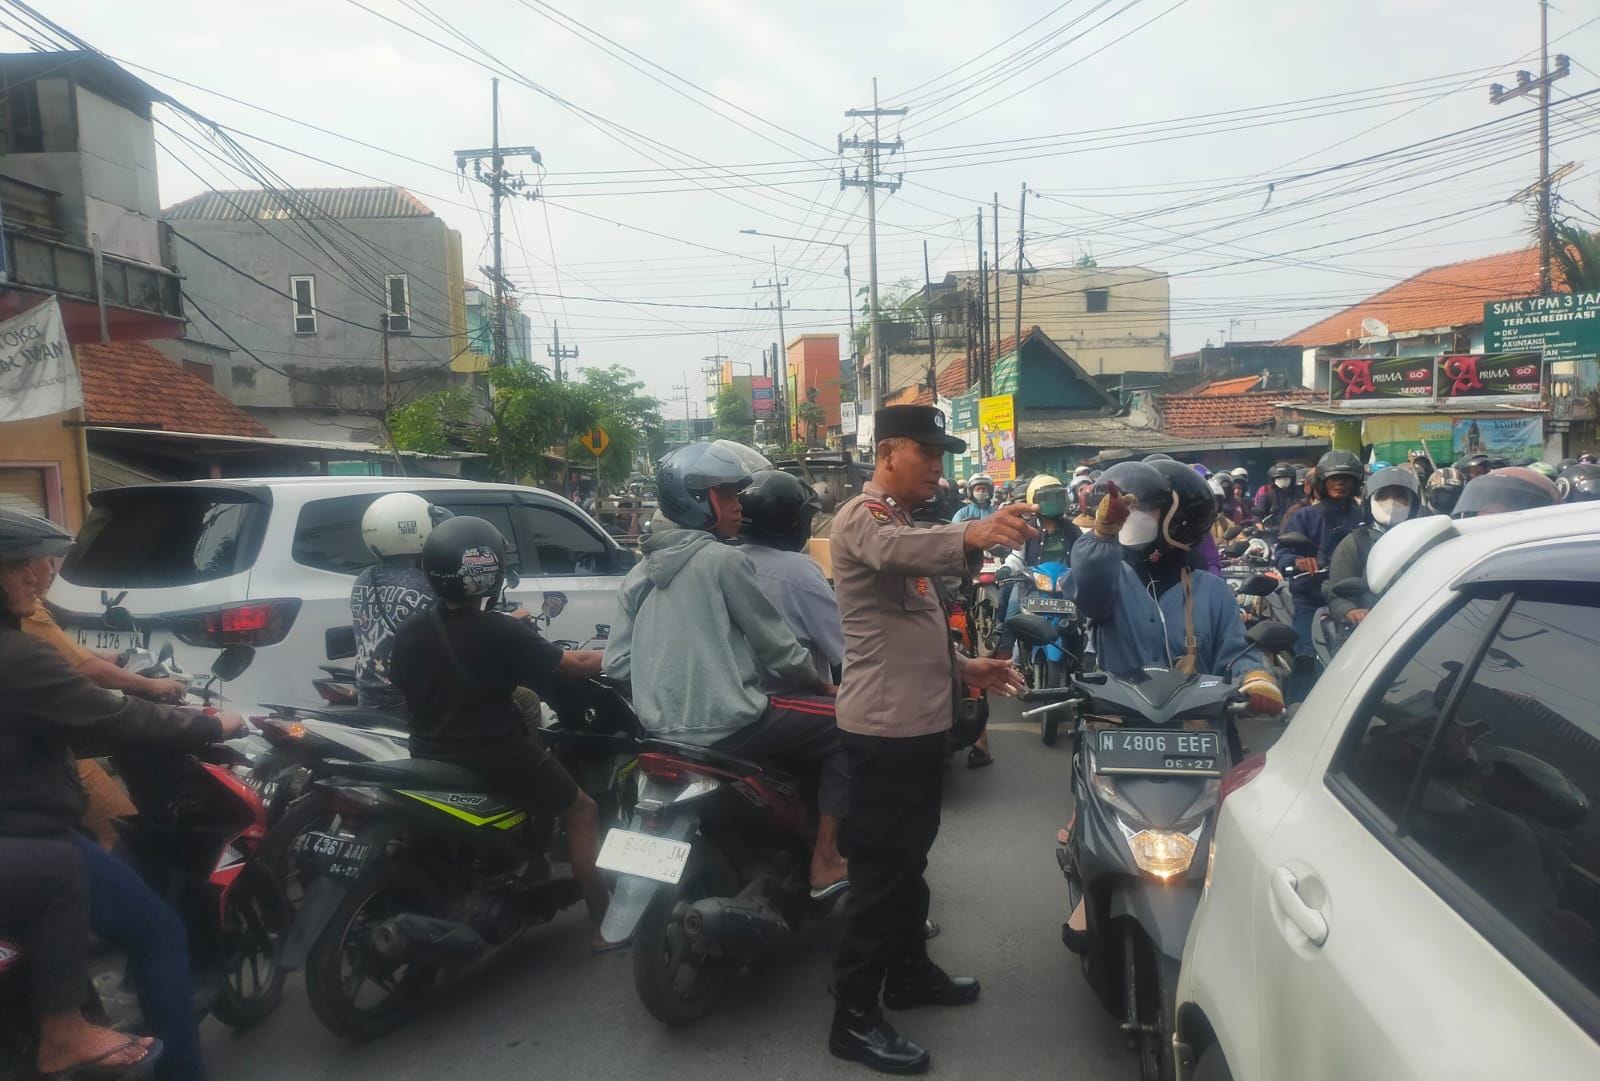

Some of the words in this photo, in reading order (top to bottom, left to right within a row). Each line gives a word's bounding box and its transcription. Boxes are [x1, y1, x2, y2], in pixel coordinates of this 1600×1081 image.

[1493, 301, 1523, 315] SMK
[1528, 297, 1560, 310] YPM
[1563, 295, 1573, 307] 3
[1502, 310, 1596, 327] TERAKREDITASI
[1372, 372, 1402, 383] PRIMA
[1479, 368, 1510, 380] PRIMA
[96, 632, 120, 649] 1176
[1103, 735, 1114, 750] N
[1122, 735, 1167, 751] 4806
[1177, 736, 1211, 753] EEF
